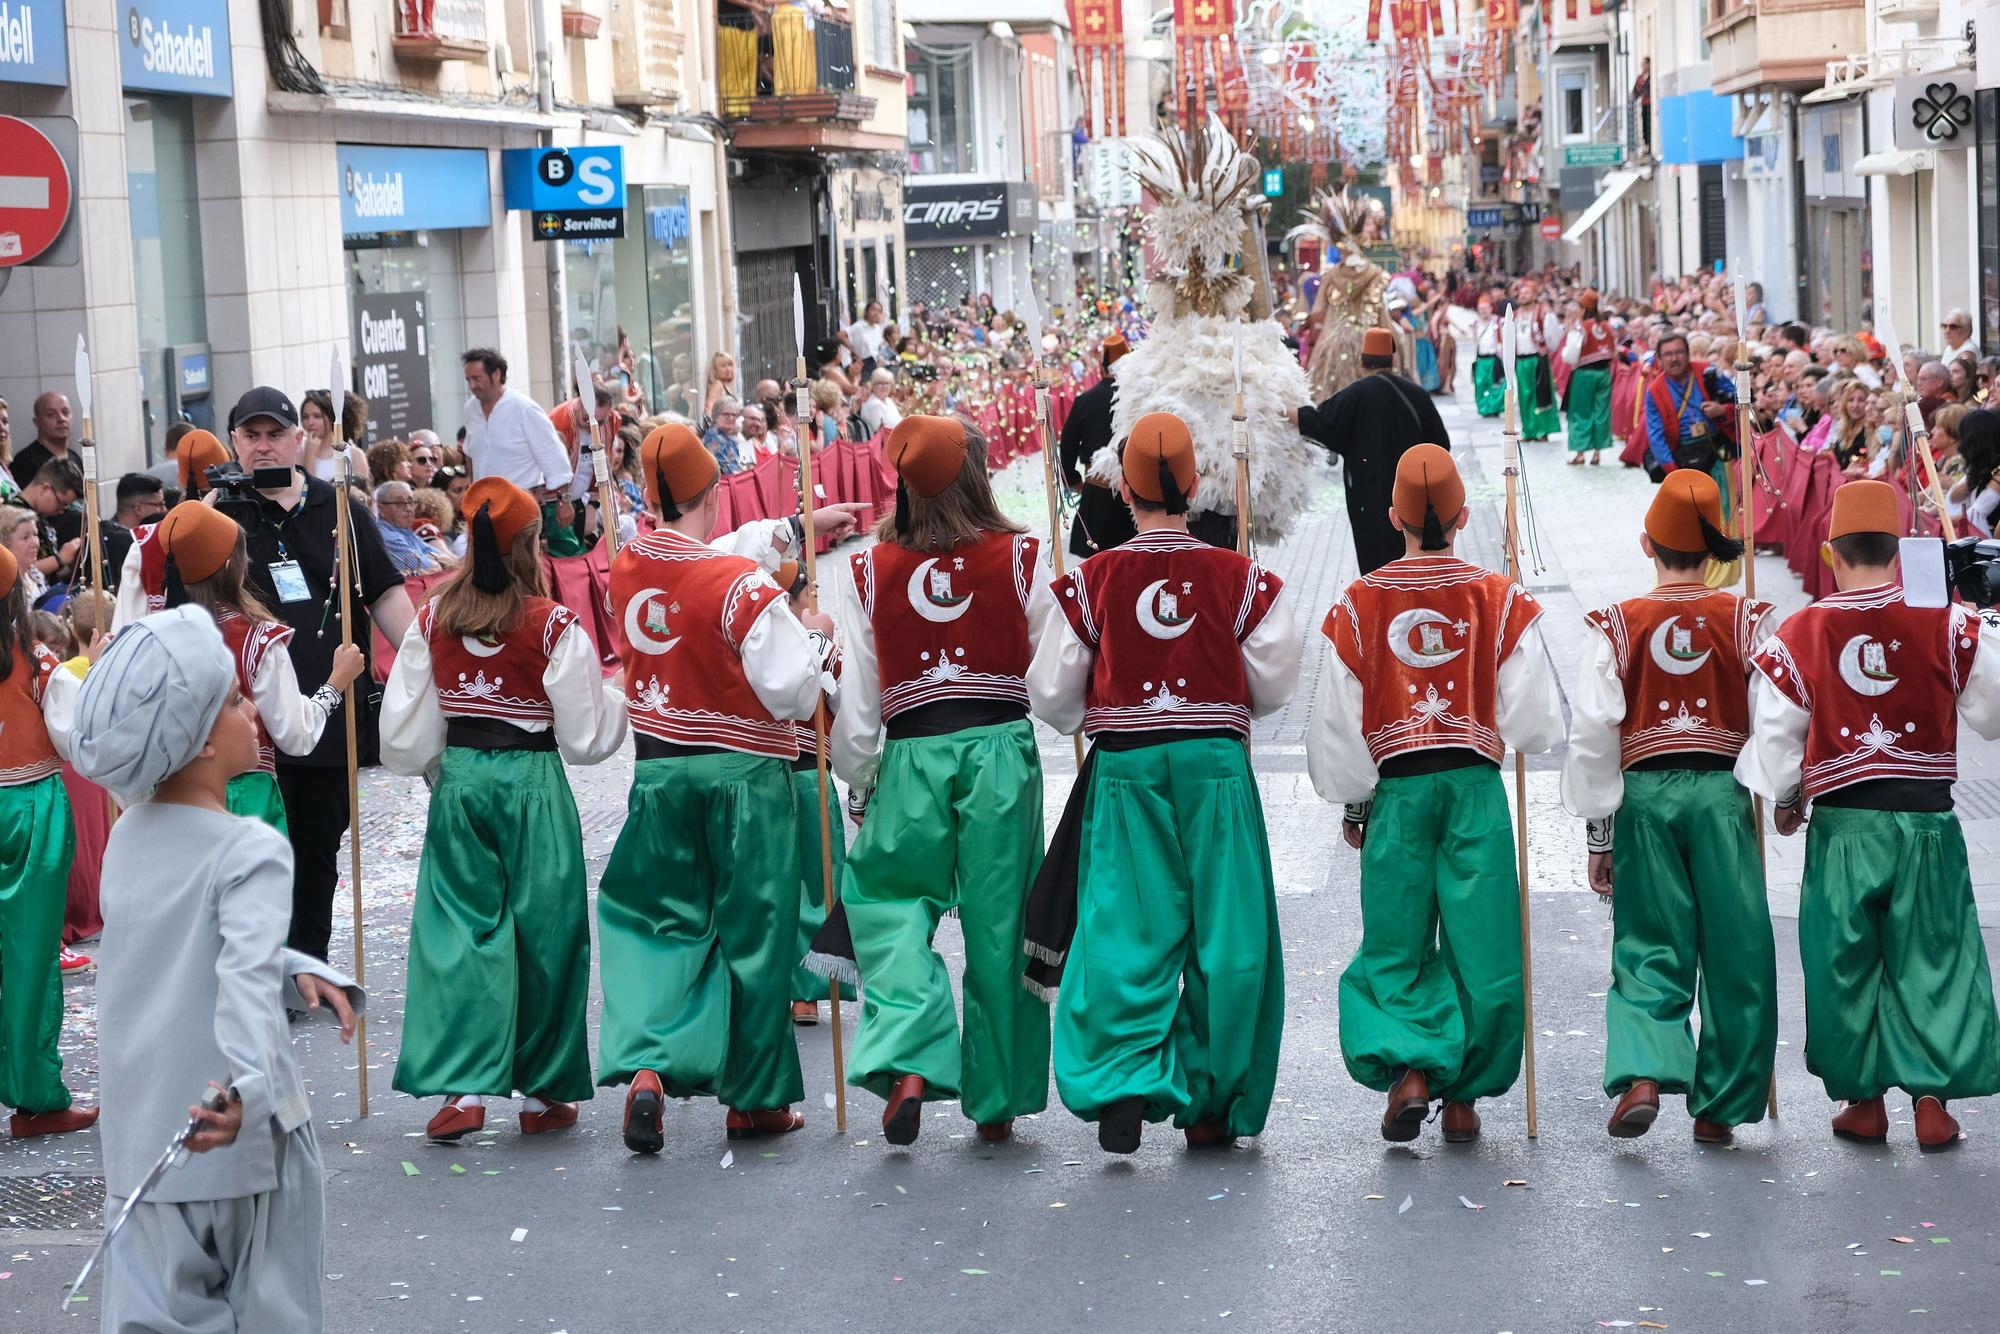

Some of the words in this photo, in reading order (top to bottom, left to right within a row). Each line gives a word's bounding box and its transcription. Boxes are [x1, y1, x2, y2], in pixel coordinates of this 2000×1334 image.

[142, 17, 214, 78] Sabadell
[354, 172, 405, 218] Sabadell
[549, 159, 564, 178] B
[577, 156, 615, 205] S
[564, 217, 617, 231] ServiRed
[902, 199, 1003, 224] CIMAS
[361, 309, 406, 354] Cuenta
[364, 364, 388, 399] con
